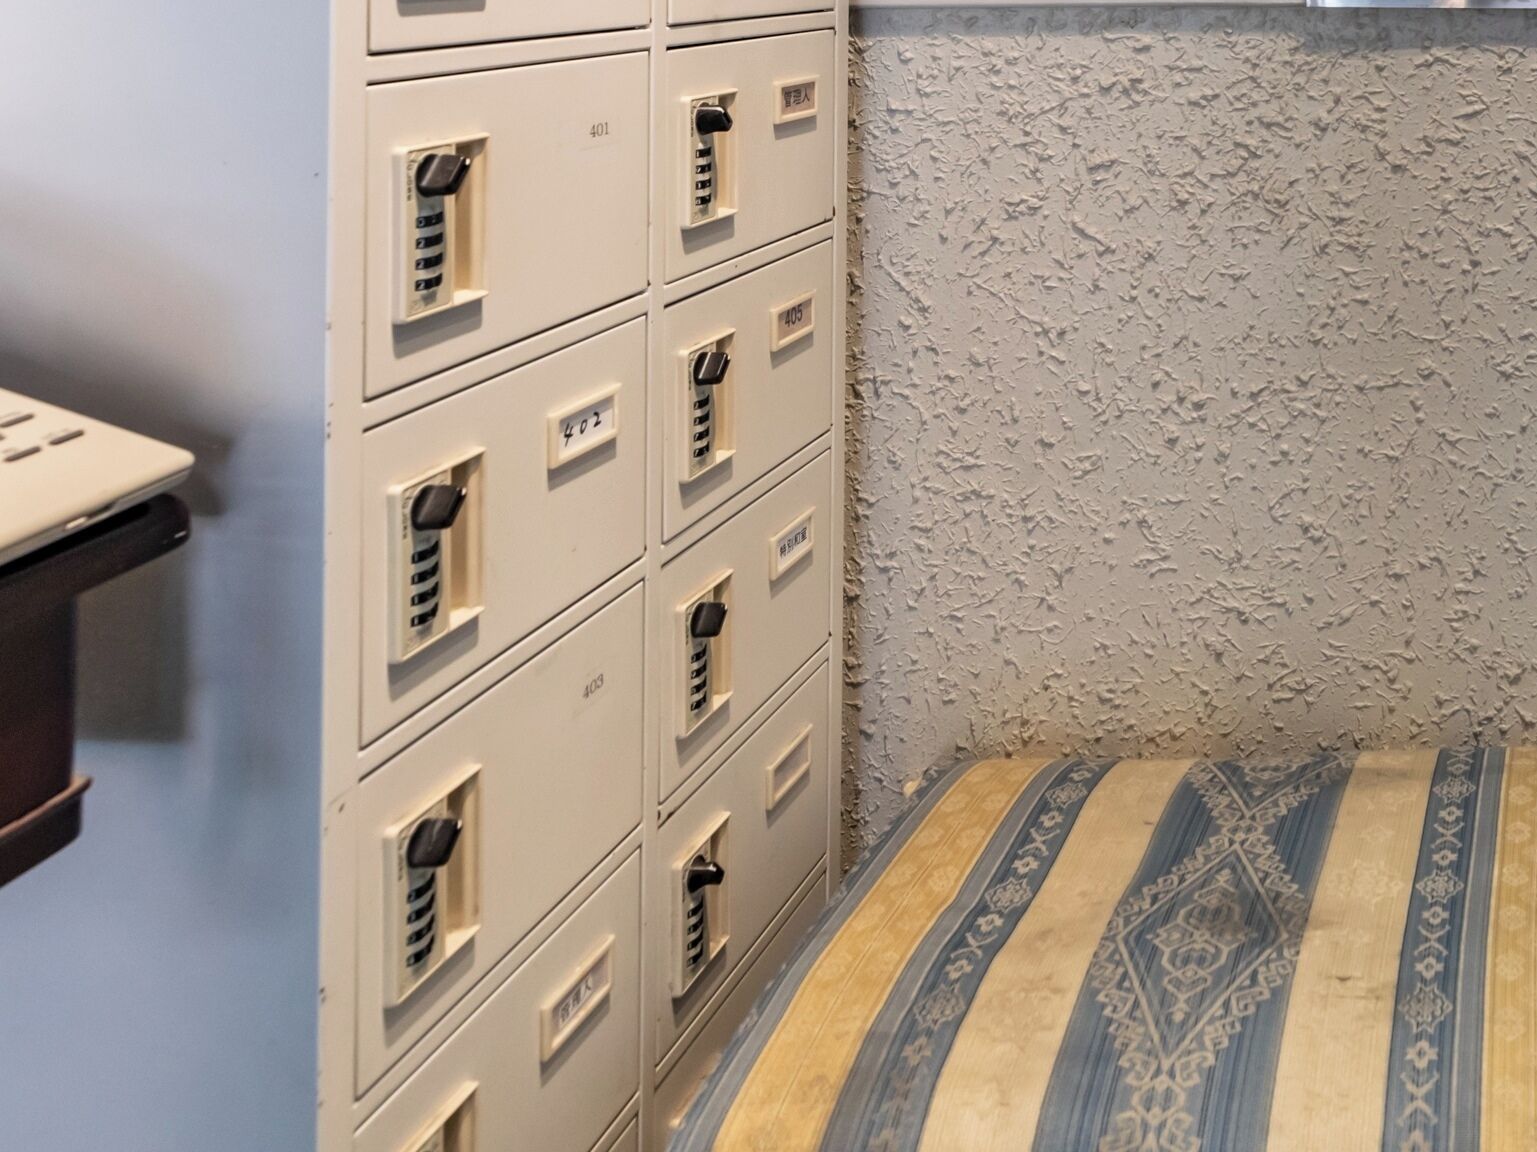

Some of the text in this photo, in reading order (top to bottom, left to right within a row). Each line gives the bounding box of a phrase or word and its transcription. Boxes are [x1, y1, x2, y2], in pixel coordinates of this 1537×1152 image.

[589, 122, 609, 138] 401
[785, 303, 803, 327] 405
[563, 411, 601, 447] 402
[582, 673, 604, 698] 403
